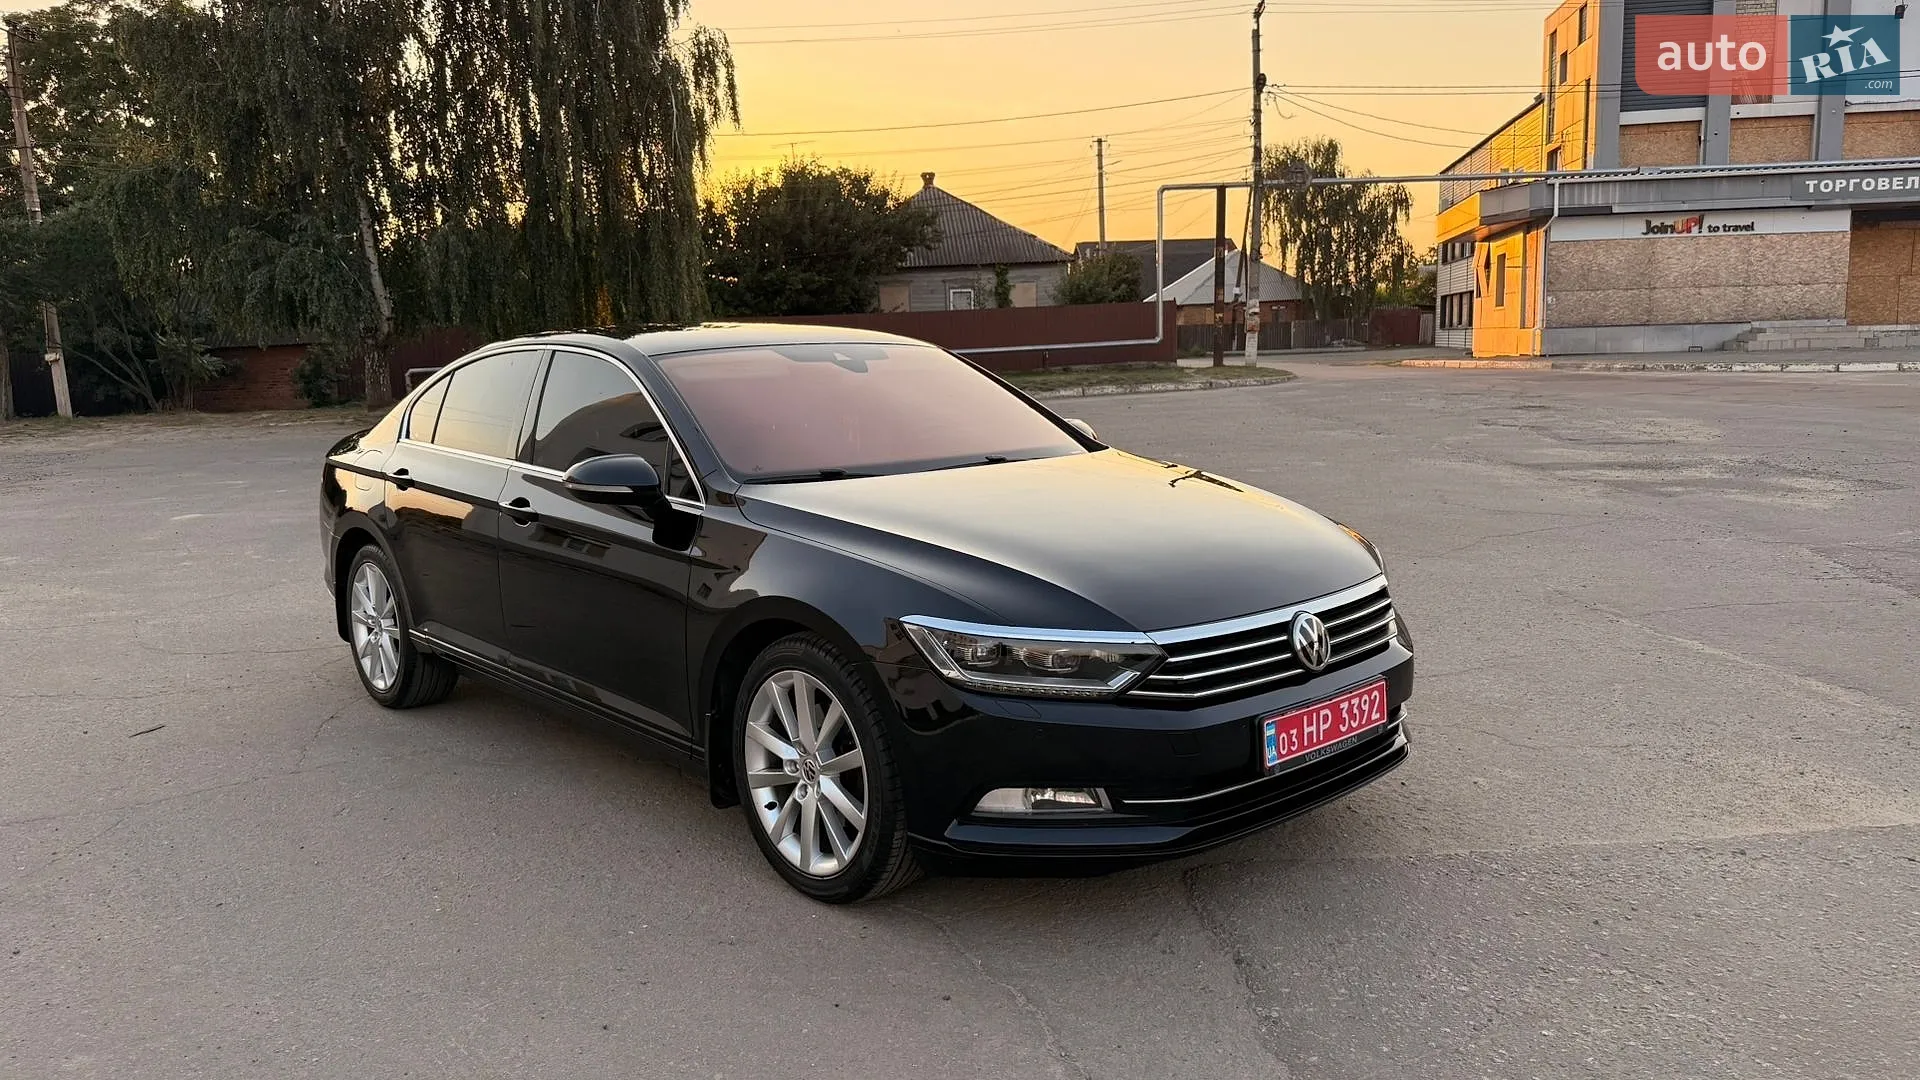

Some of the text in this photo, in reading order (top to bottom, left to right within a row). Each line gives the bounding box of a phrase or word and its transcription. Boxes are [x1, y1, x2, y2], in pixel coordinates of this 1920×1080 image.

[1707, 224, 1720, 233] to
[1722, 221, 1755, 232] travel
[1339, 690, 1380, 732] 3392
[1304, 735, 1358, 762] VOLKSWAGEN
